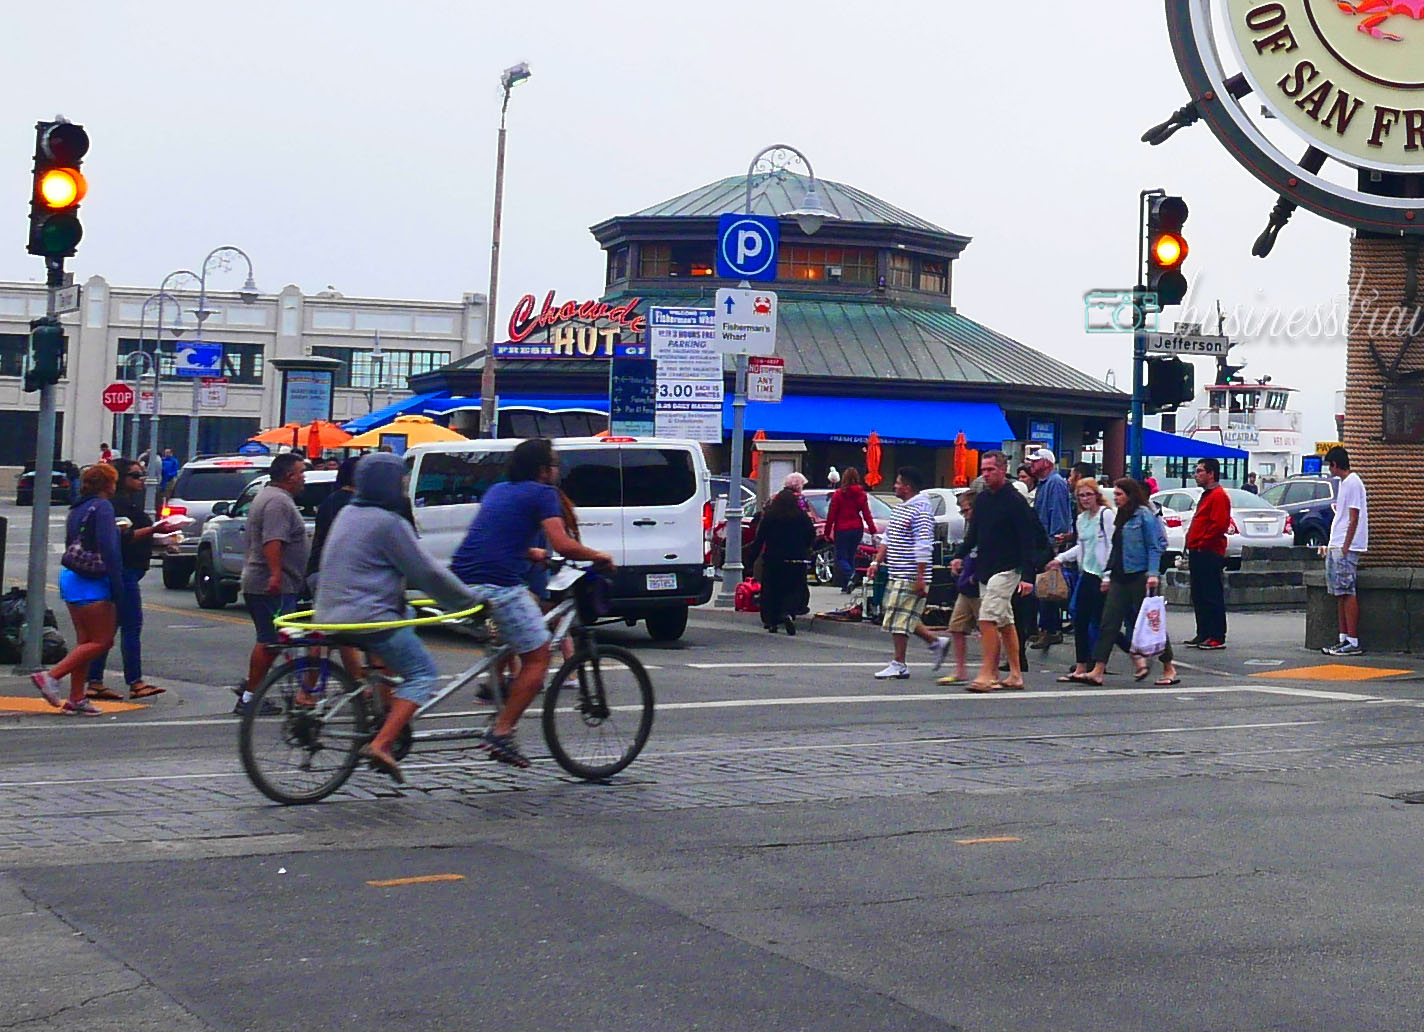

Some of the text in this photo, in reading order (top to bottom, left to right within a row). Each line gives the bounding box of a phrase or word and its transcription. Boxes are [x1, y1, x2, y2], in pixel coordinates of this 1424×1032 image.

[1244, 1, 1299, 57] OF
[1278, 59, 1364, 136] SAN
[508, 289, 646, 343] Chowde
[722, 322, 771, 333] Fisherman's
[678, 330, 701, 338] HOURS
[722, 333, 747, 341] Wharf
[553, 326, 621, 356] HUT
[668, 340, 707, 348] PARKING
[1154, 337, 1222, 352] Jefferson
[497, 346, 552, 355] FRESH
[757, 376, 774, 384] ANY
[756, 384, 774, 392] TIME
[104, 391, 132, 404] STOP
[1224, 432, 1259, 442] ALCATRAZ
